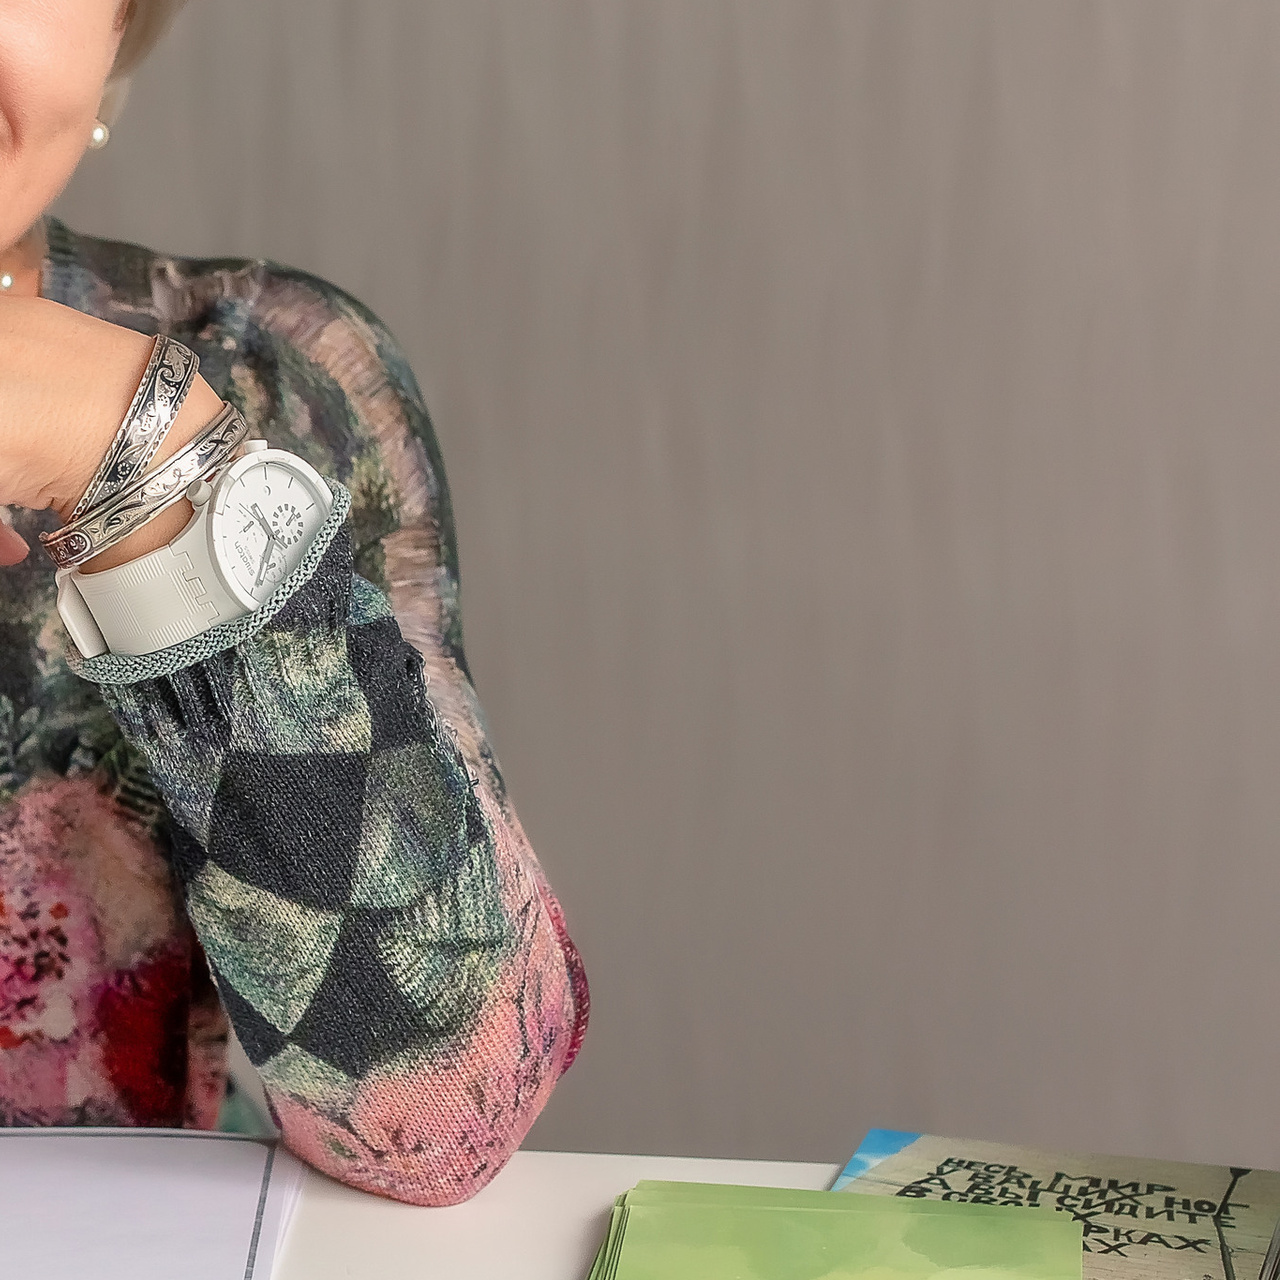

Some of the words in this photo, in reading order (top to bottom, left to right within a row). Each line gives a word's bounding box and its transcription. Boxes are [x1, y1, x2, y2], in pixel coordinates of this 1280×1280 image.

[912, 1176, 951, 1190] А
[965, 1183, 1040, 1201] ВЫ
[968, 1172, 1153, 1204] ВАШИХ
[1047, 1172, 1176, 1194] МИР
